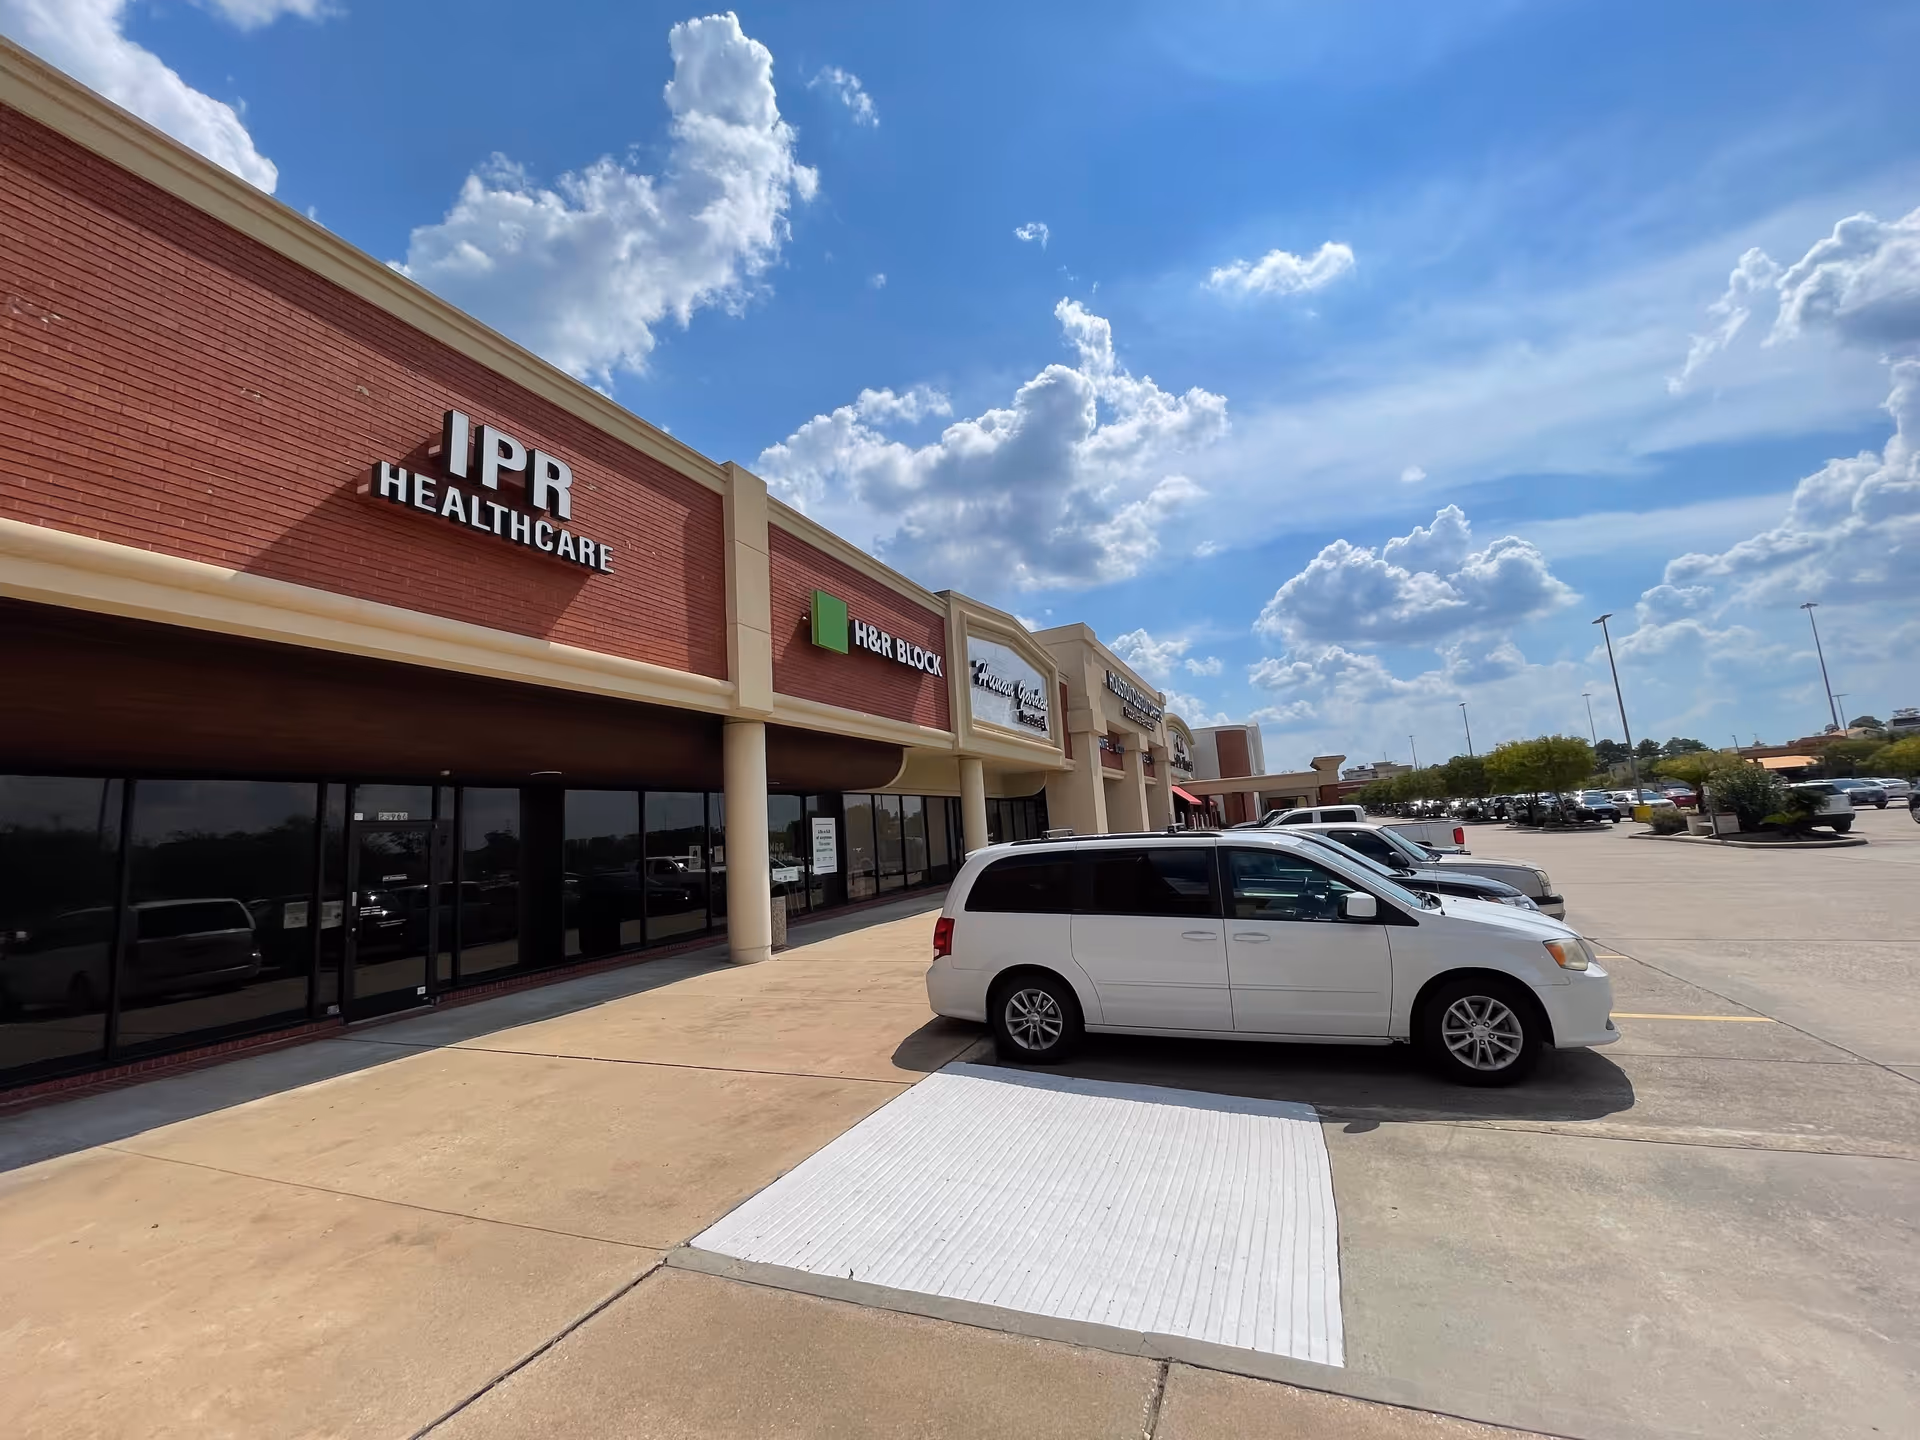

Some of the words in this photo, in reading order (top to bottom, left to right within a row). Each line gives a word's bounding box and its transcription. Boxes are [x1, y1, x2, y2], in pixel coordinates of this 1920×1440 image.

[377, 460, 615, 574] HEALTHCARE
[446, 409, 573, 521] IPR
[854, 619, 893, 659] H&R
[896, 637, 943, 677] BLOCK
